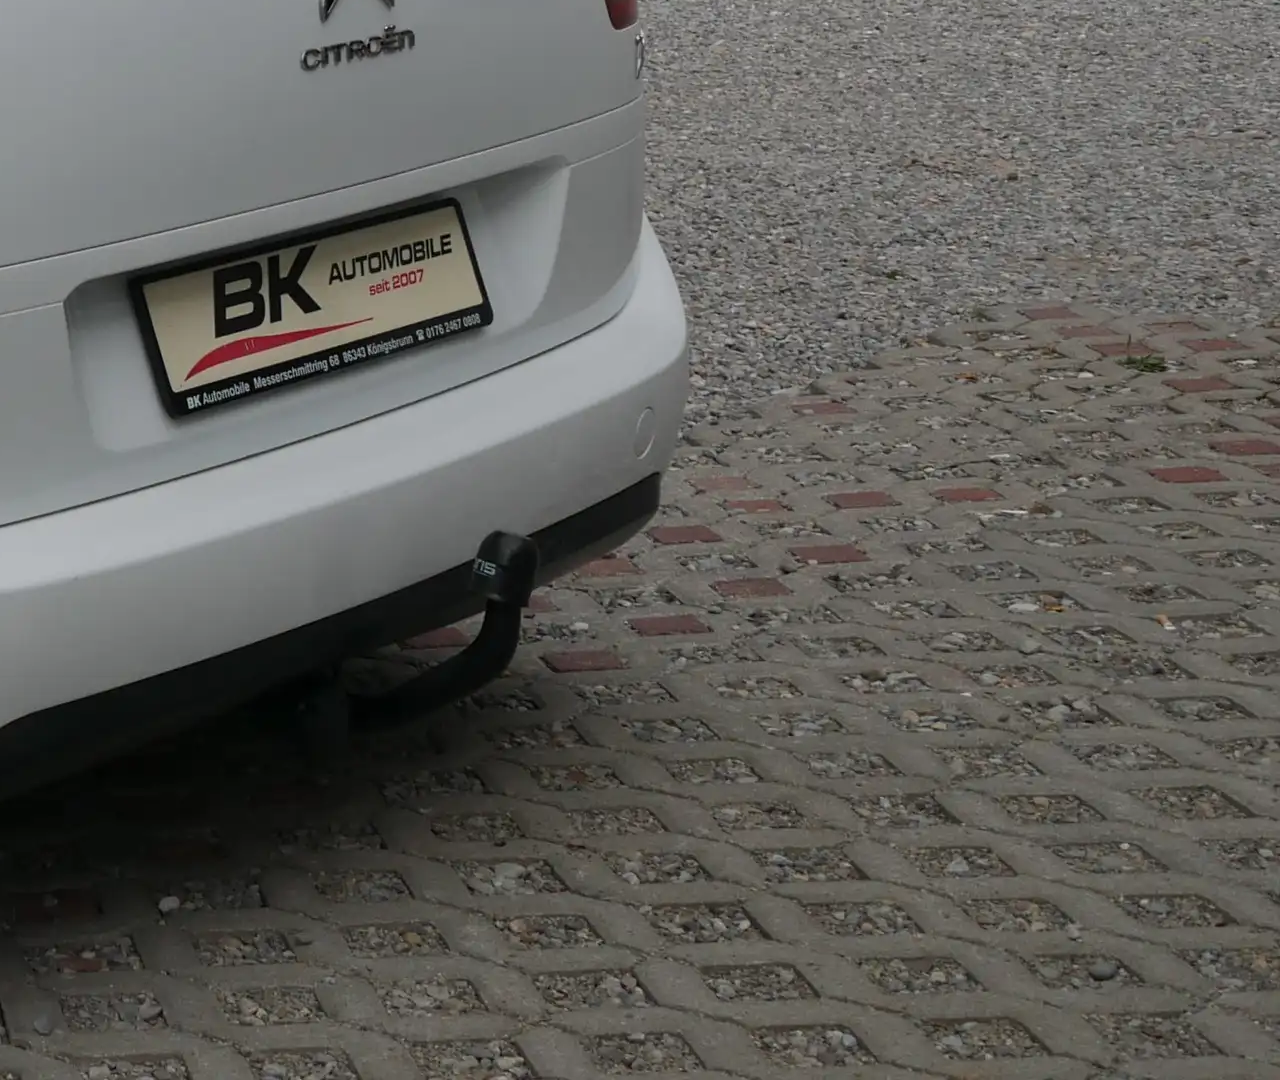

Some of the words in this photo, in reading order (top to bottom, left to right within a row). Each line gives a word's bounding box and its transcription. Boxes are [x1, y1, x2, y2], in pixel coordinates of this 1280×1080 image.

[213, 244, 322, 339] BK
[328, 233, 452, 286] AUTOMOBILE
[368, 278, 391, 296] seit
[391, 268, 425, 289] 2007
[186, 394, 202, 410] BK
[202, 381, 250, 406] Automobile
[253, 359, 329, 389] Messerschmittring
[328, 354, 340, 367] 68
[342, 346, 367, 364] 86343
[367, 334, 414, 355] Königsbrunn
[425, 324, 445, 339] 0176
